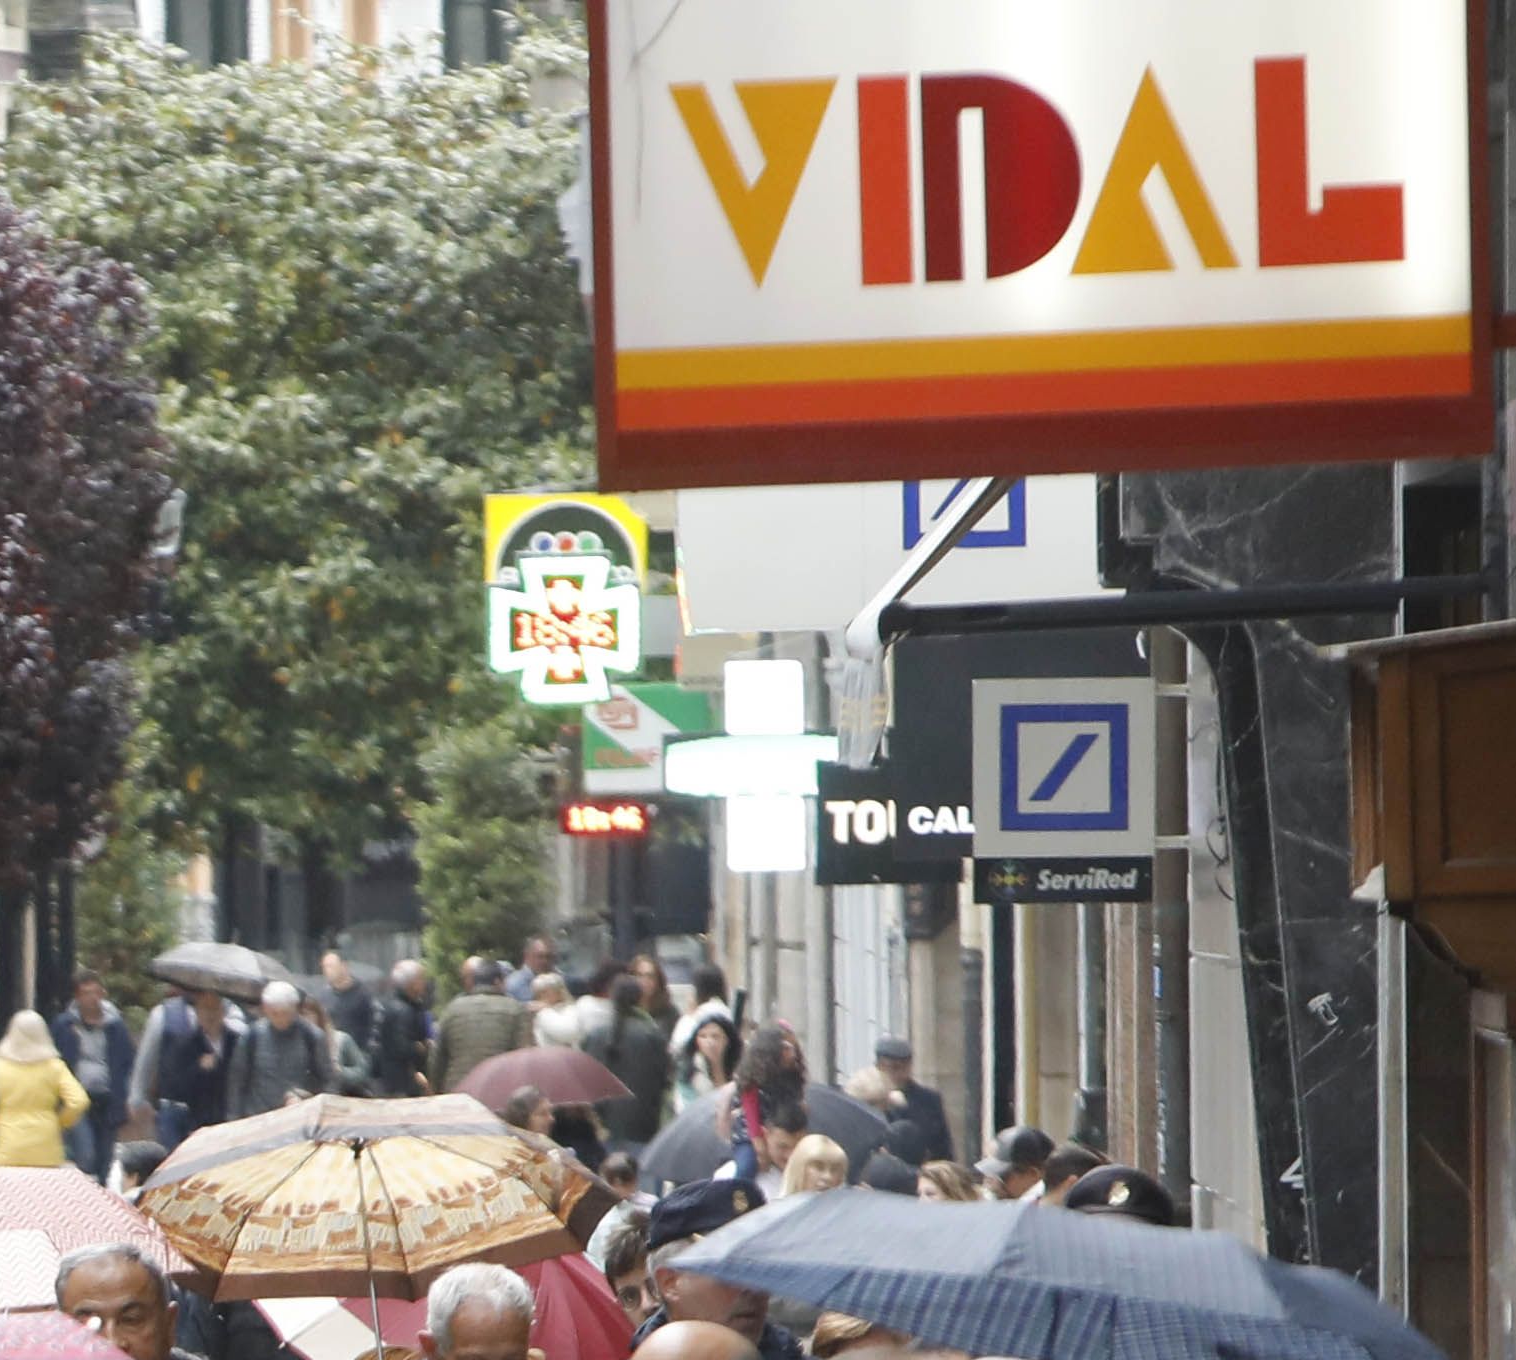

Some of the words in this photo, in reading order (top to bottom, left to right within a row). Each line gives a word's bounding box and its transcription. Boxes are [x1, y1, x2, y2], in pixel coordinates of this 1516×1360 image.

[668, 54, 1405, 289] VIDAL
[825, 799, 897, 845] TO
[1037, 867, 1139, 891] ServiRed
